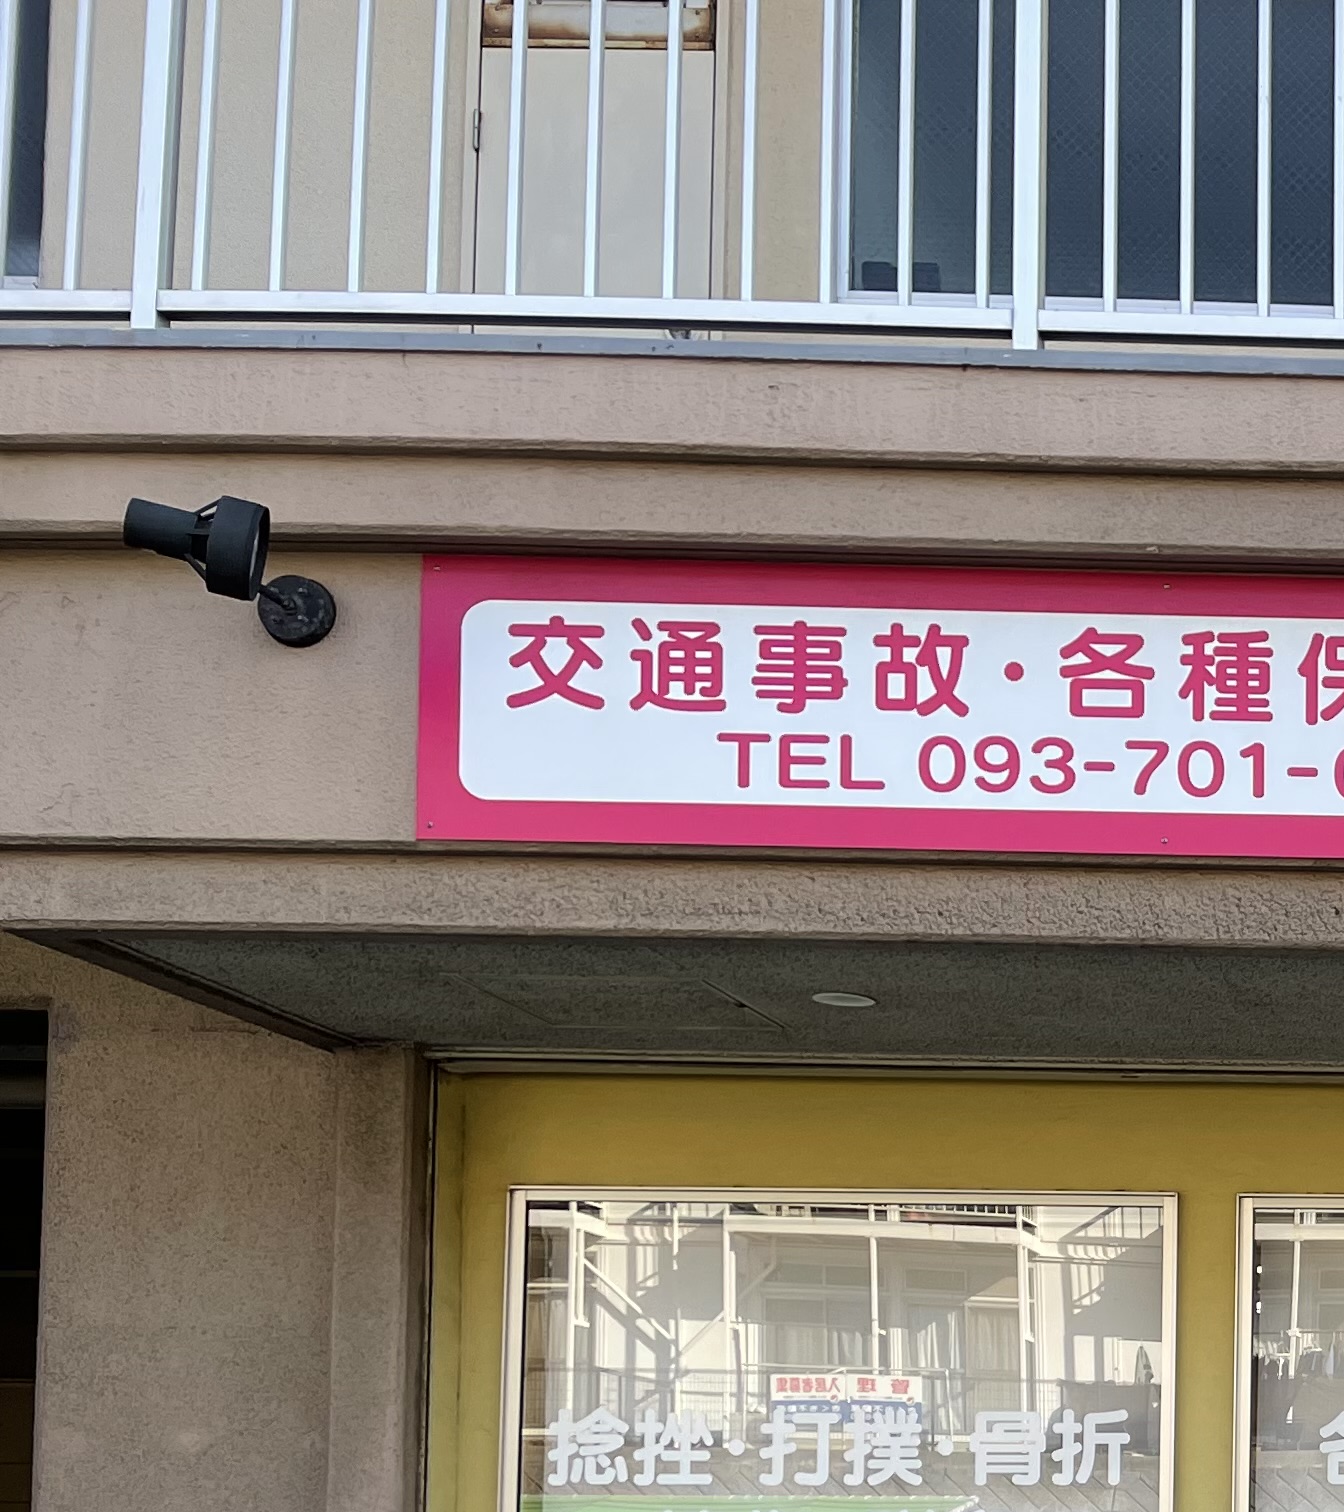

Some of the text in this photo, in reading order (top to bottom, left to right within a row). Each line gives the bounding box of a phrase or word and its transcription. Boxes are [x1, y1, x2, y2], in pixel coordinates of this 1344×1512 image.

[716, 731, 885, 791] TEL
[546, 1408, 1131, 1487] 捻挫・打撲・骨折
